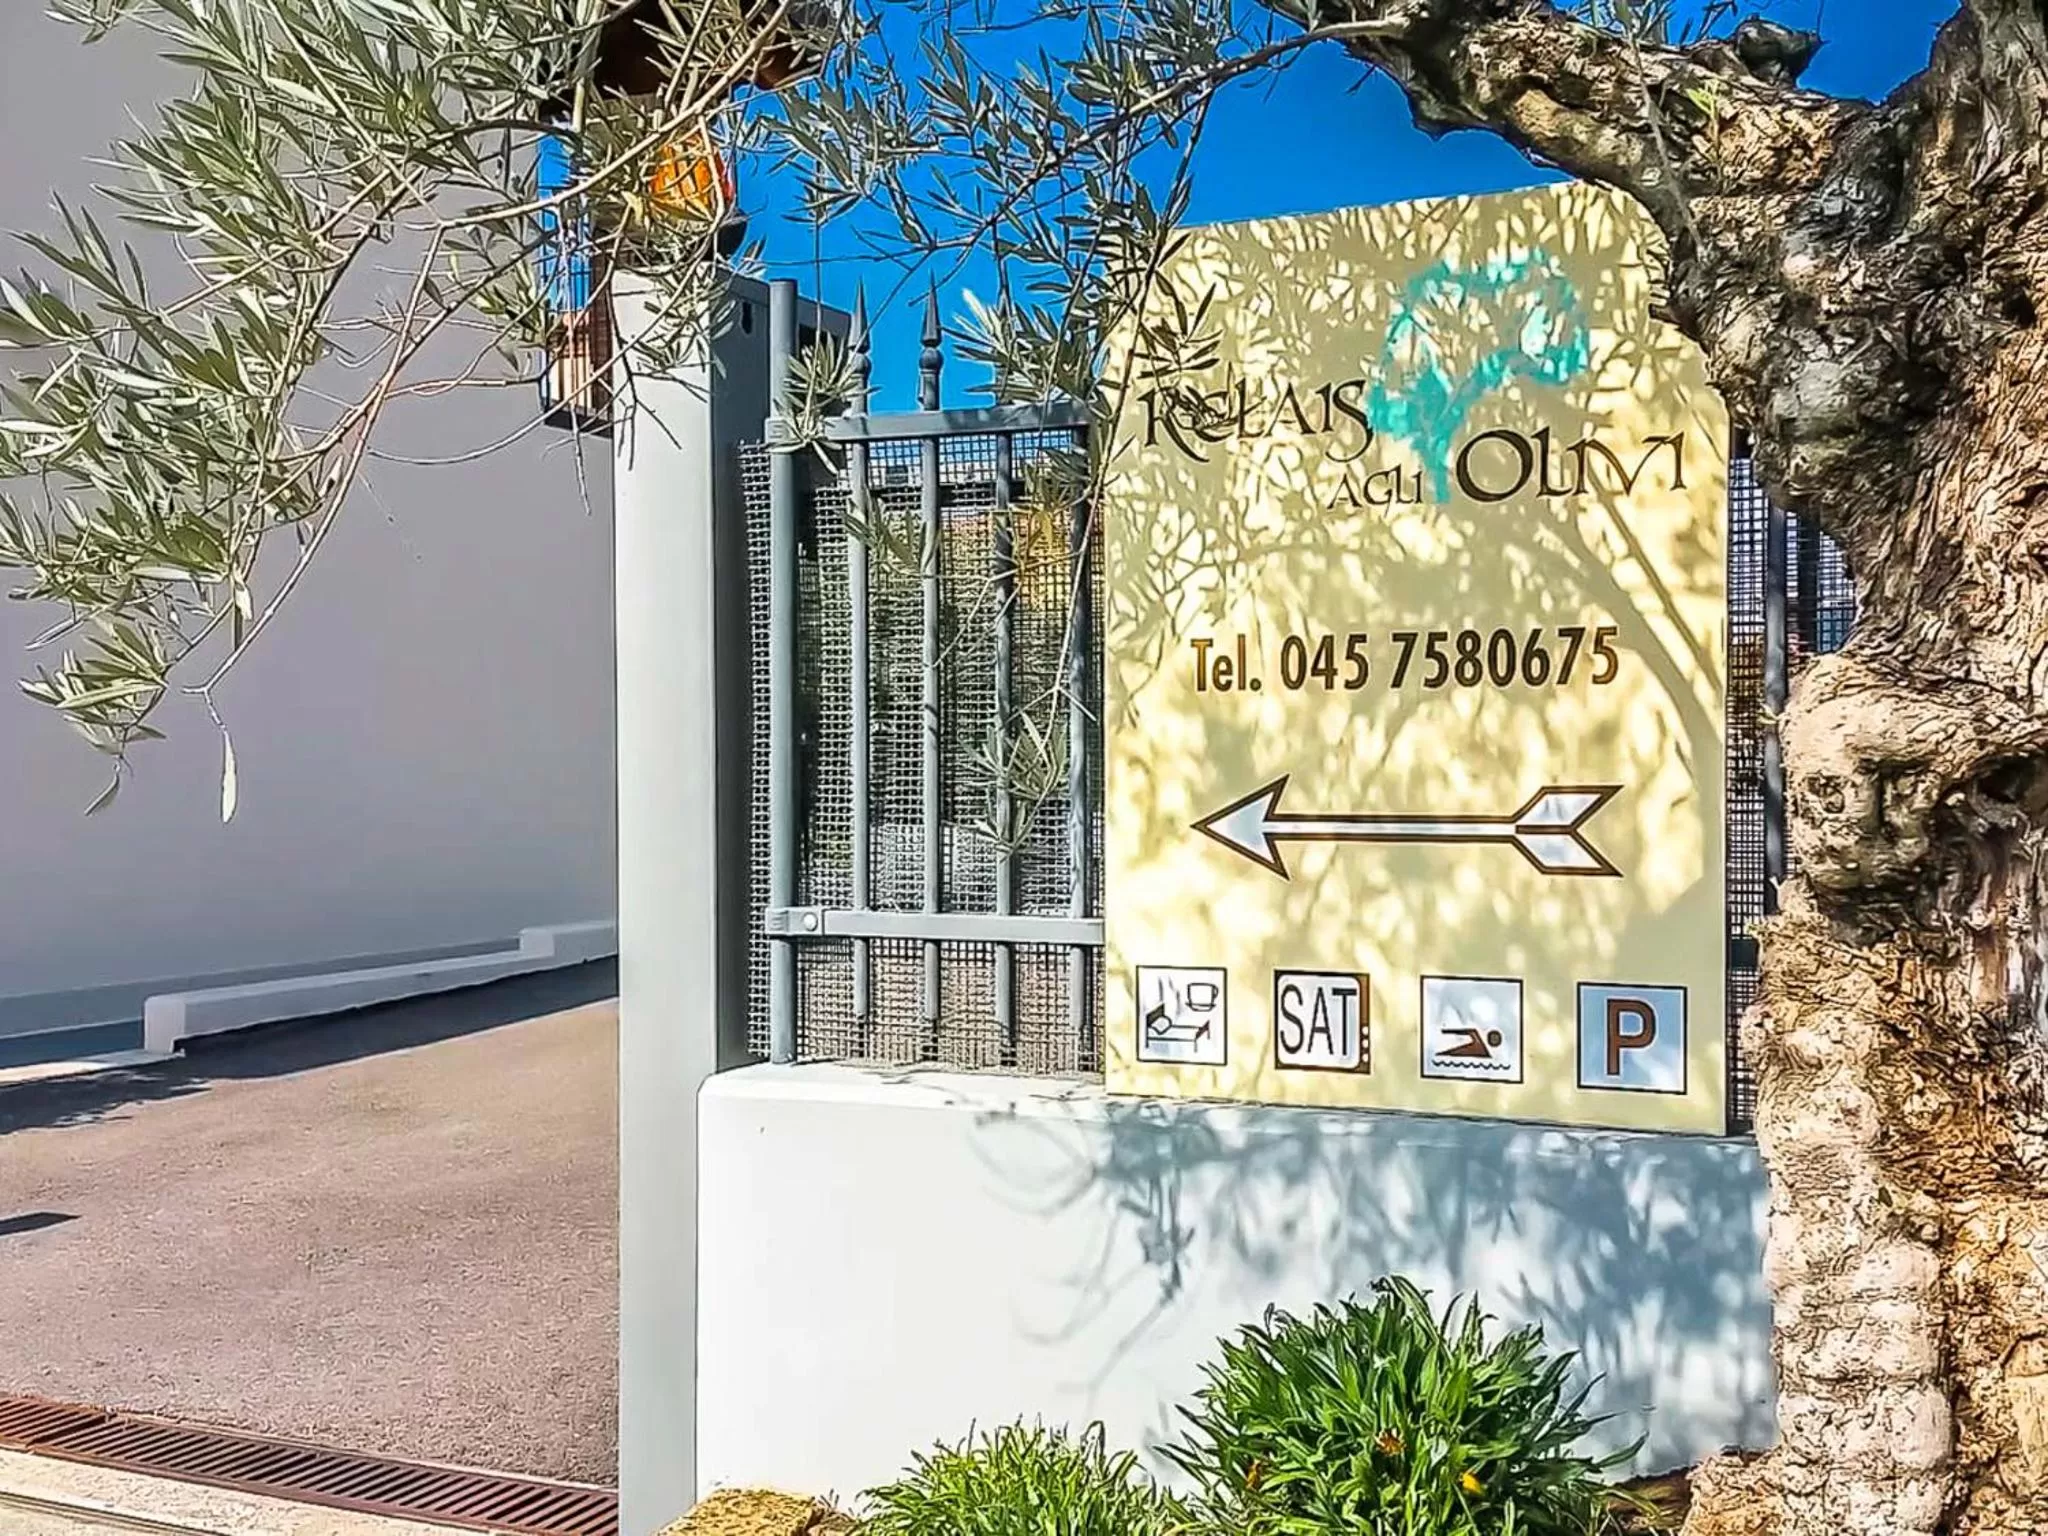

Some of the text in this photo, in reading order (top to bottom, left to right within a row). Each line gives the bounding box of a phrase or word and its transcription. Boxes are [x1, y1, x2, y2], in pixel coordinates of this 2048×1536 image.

[1327, 426, 1687, 514] AGLI OLIVI
[1190, 626, 1619, 692] Tel. 045 7580675
[1279, 984, 1358, 1056] SAT
[1606, 998, 1656, 1076] P
